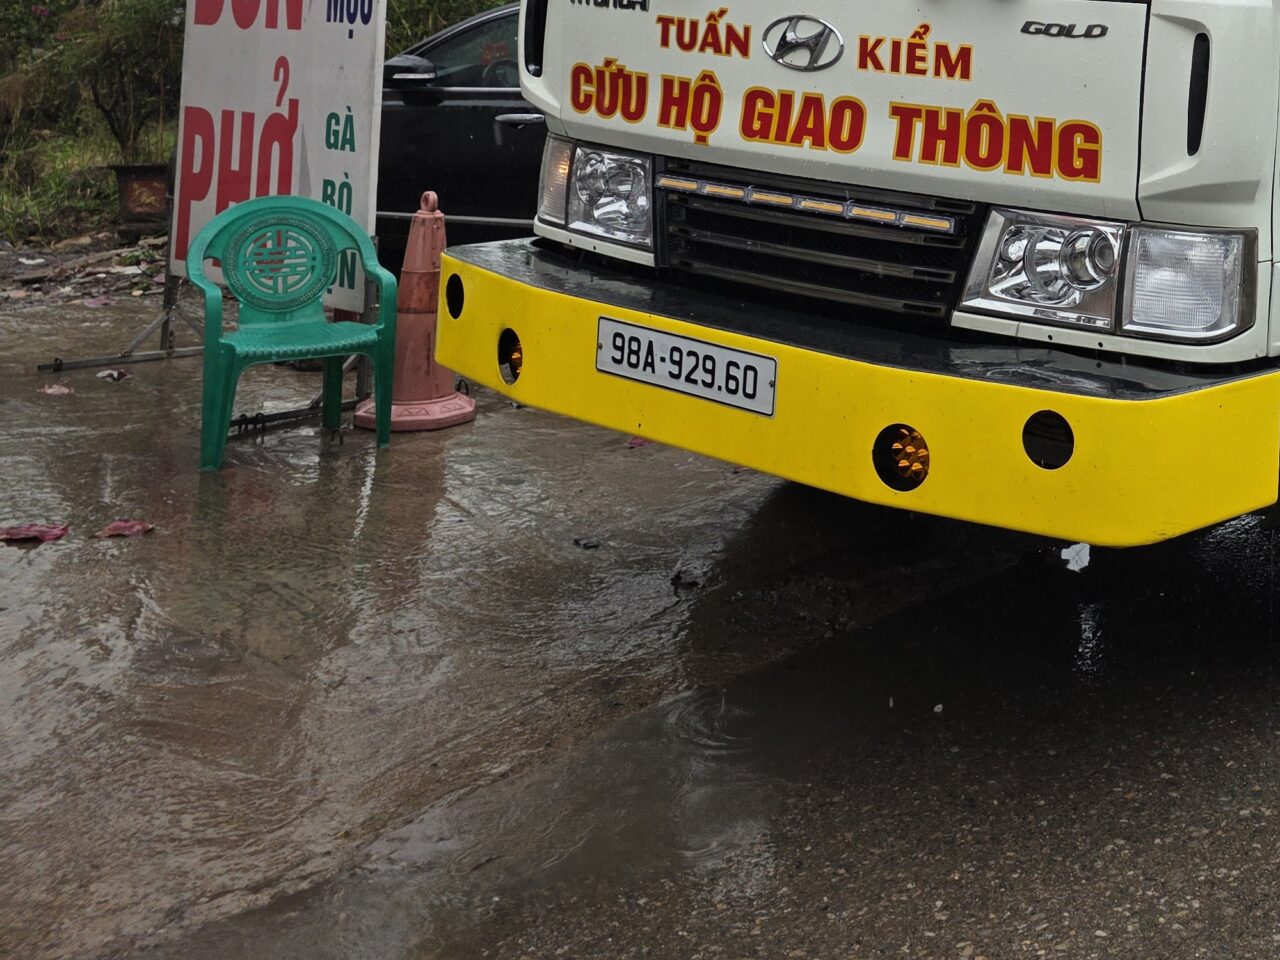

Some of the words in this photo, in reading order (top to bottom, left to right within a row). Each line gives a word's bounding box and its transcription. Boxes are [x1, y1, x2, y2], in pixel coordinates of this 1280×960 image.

[656, 7, 752, 60] TUẤN
[856, 22, 974, 82] KIỂM
[1020, 19, 1109, 39] GOLD
[325, 105, 356, 152] GÀ
[569, 56, 649, 124] CỨU
[656, 69, 723, 146] HỘ
[739, 85, 867, 155] GIAO
[888, 98, 1103, 184] THÔNG
[174, 55, 299, 269] PHỞ
[610, 331, 758, 400] 98A-929.60
